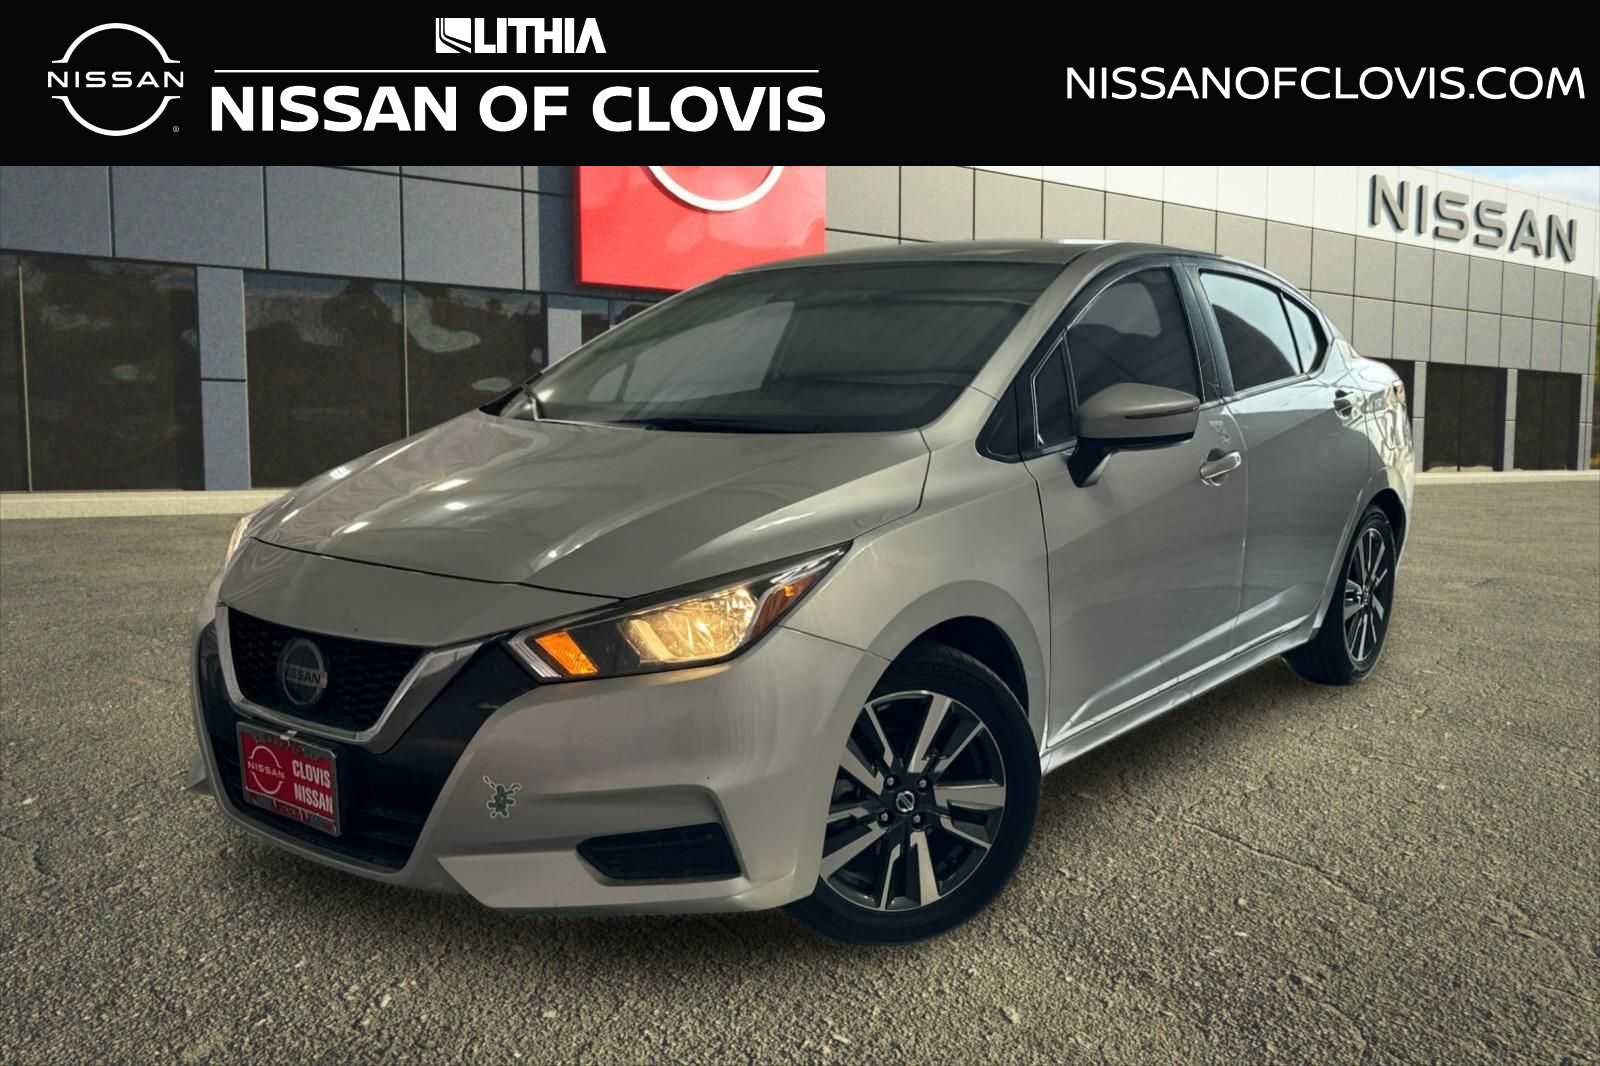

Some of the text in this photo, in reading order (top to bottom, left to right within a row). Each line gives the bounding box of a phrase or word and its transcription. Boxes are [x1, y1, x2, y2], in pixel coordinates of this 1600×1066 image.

[1369, 174, 1577, 263] NISSAN
[287, 666, 321, 686] SAN
[248, 761, 285, 779] NISSAN
[292, 760, 331, 788] CLOVIS
[294, 783, 333, 814] NISSAN
